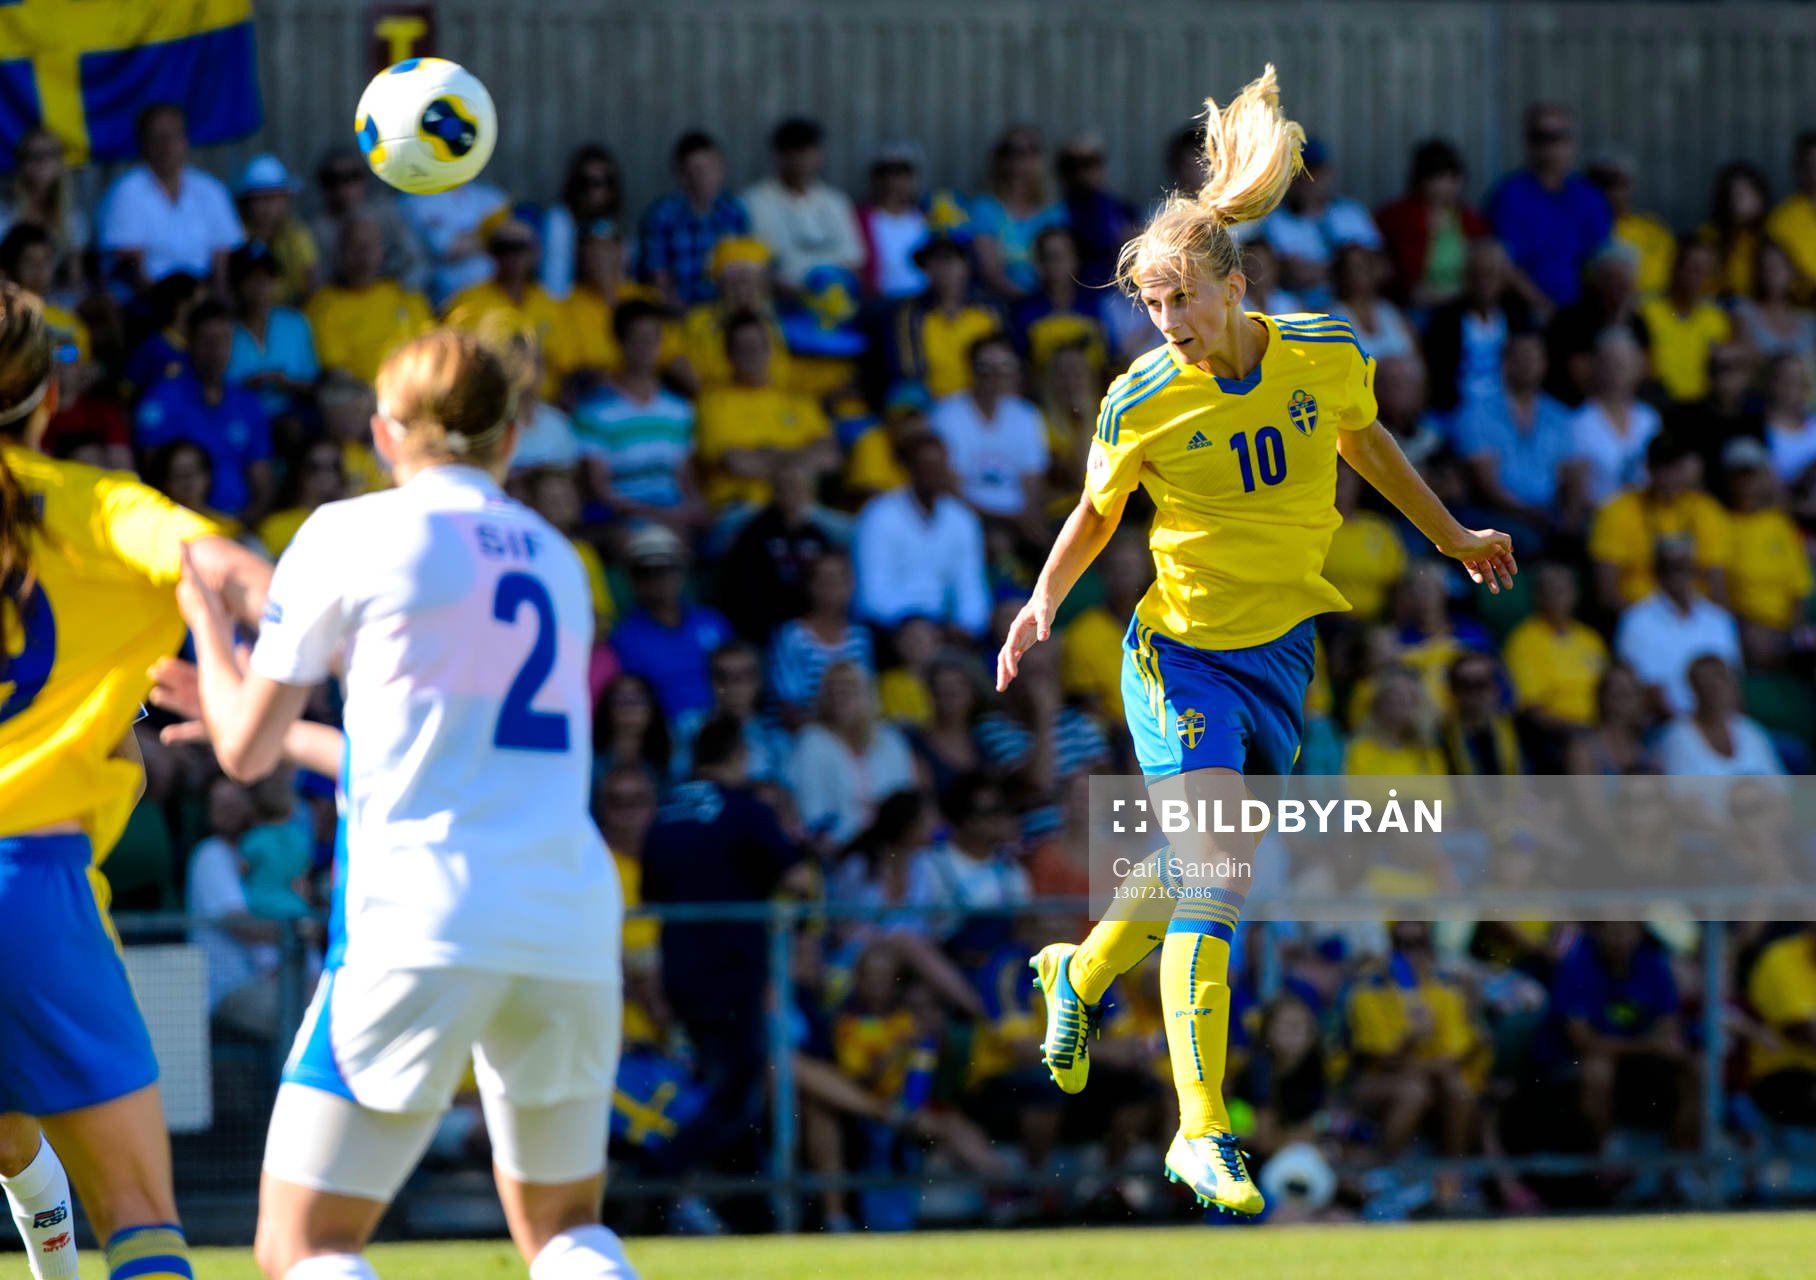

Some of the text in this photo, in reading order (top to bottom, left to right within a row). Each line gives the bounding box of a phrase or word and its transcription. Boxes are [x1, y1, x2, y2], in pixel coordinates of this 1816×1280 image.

[1229, 426, 1287, 493] 10
[476, 523, 541, 560] SIF
[493, 570, 570, 752] 2
